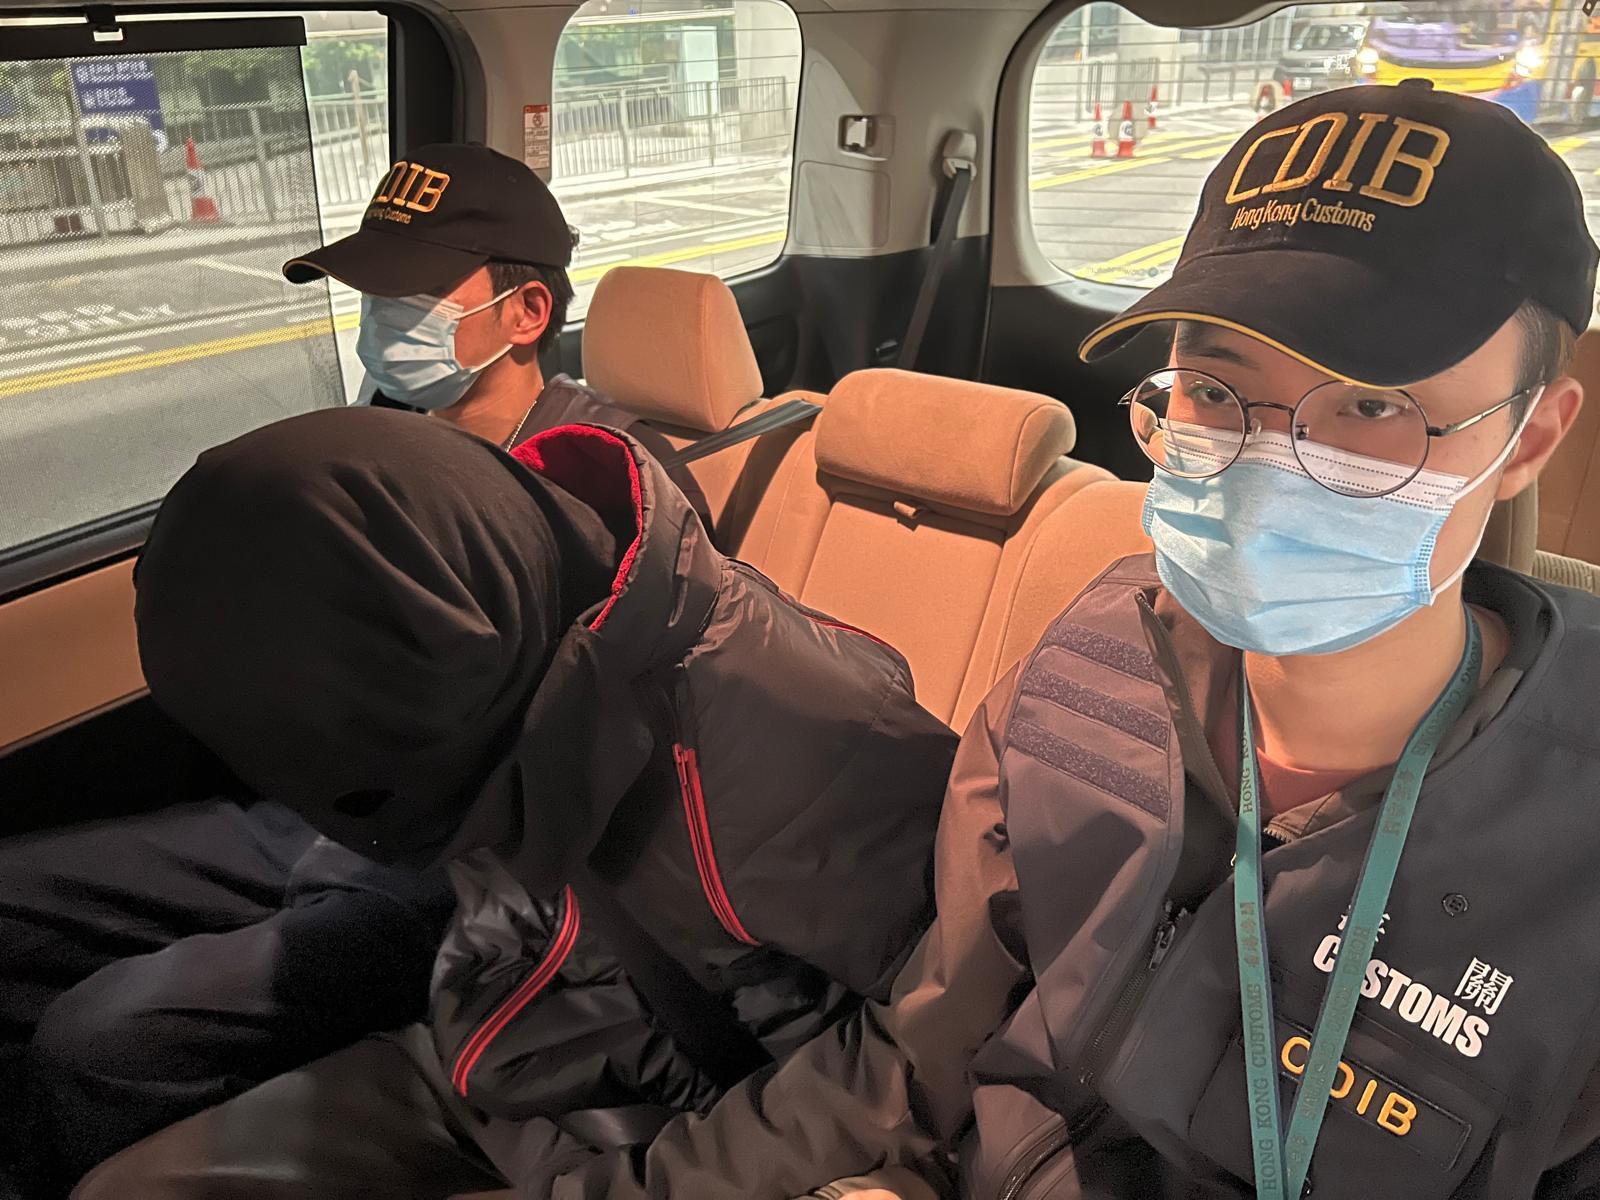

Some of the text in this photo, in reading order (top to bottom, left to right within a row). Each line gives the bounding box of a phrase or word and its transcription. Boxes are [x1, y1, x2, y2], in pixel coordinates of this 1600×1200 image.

[374, 161, 450, 212] DIB
[1301, 198, 1376, 232] Customs
[1242, 768, 1253, 813] HONG
[1313, 934, 1490, 1057] CSTOMS
[1247, 984, 1276, 1190] HONG KONG CUSTOMS
